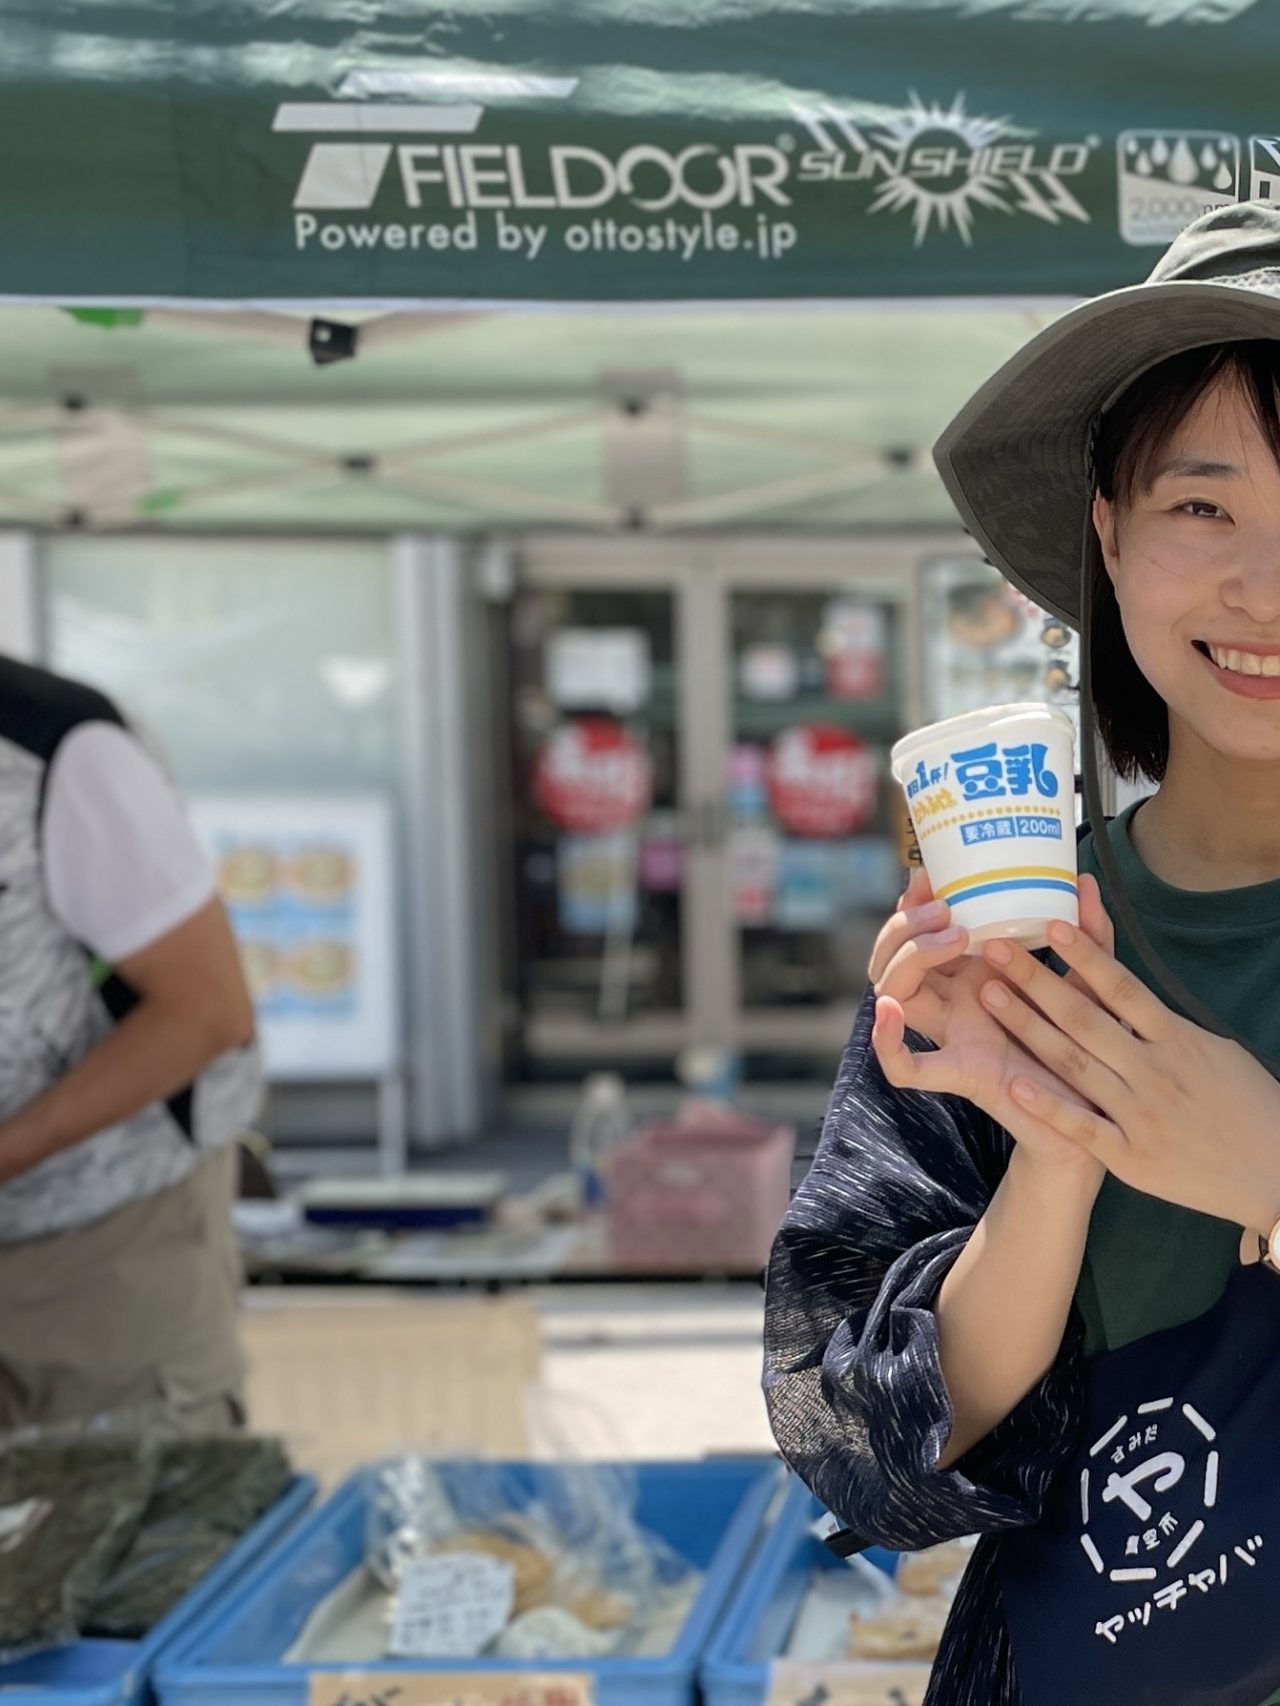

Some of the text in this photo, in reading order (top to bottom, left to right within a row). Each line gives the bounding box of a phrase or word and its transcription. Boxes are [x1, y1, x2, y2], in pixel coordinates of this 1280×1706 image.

[397, 144, 793, 211] FIELDOOR
[295, 211, 797, 260] Powered by ottostyle.jp
[951, 742, 1059, 801] 豆乳
[965, 818, 1062, 841] 要冷蔵 200ml
[1111, 1423, 1158, 1465] すみだ
[1102, 1451, 1186, 1522] や
[1095, 1534, 1264, 1643] ヤッチャバ
